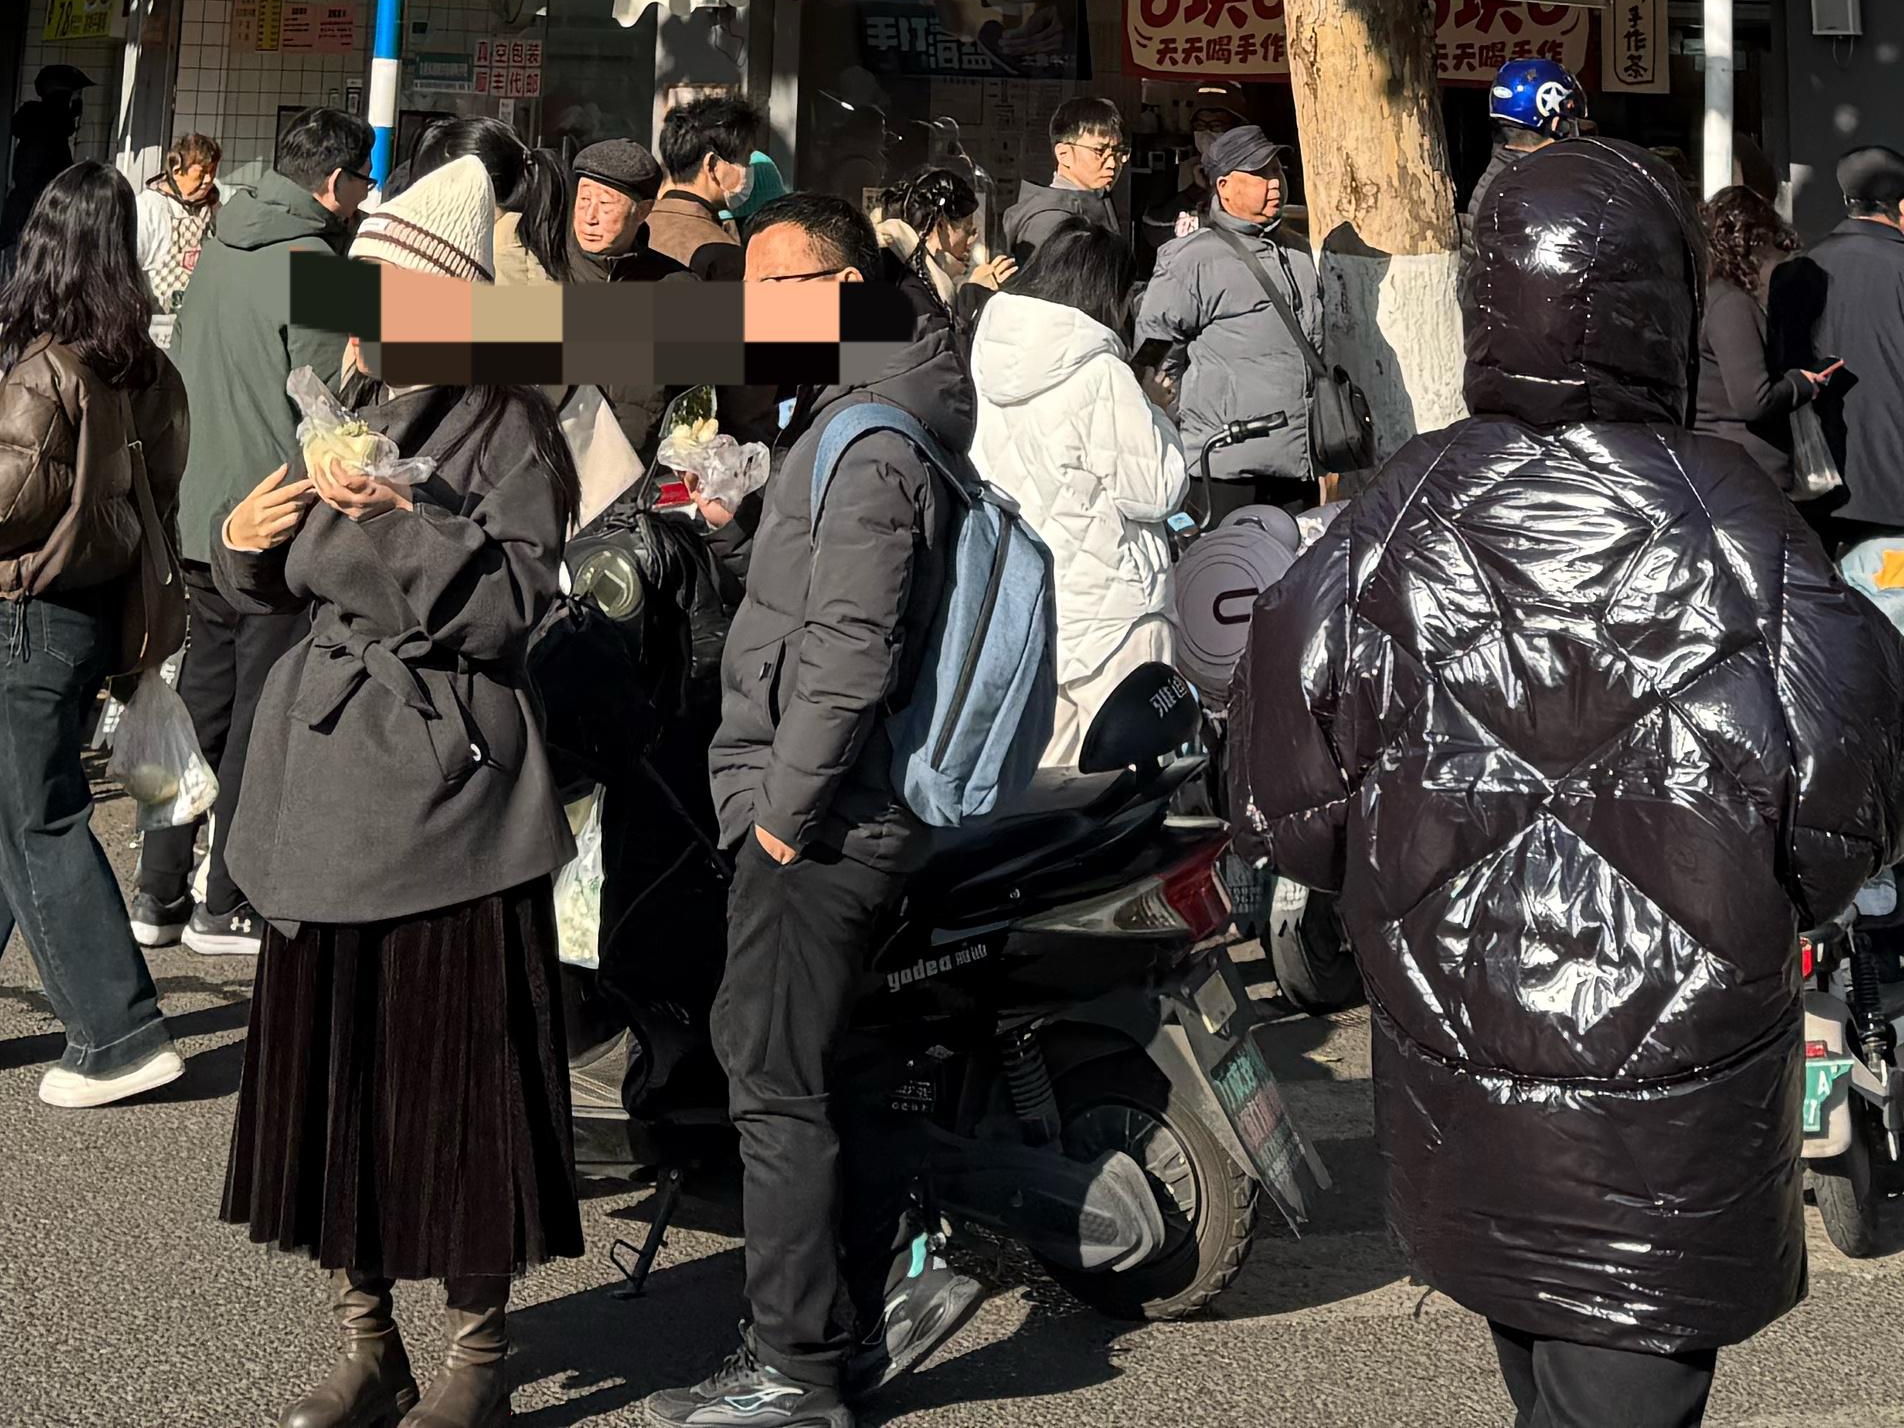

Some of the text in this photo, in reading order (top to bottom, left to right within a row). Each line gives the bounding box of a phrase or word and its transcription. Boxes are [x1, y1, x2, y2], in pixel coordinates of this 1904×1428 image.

[475, 40, 540, 64] 真空包装
[1156, 33, 1284, 66] 天天喝手作
[886, 954, 953, 994] yadea
